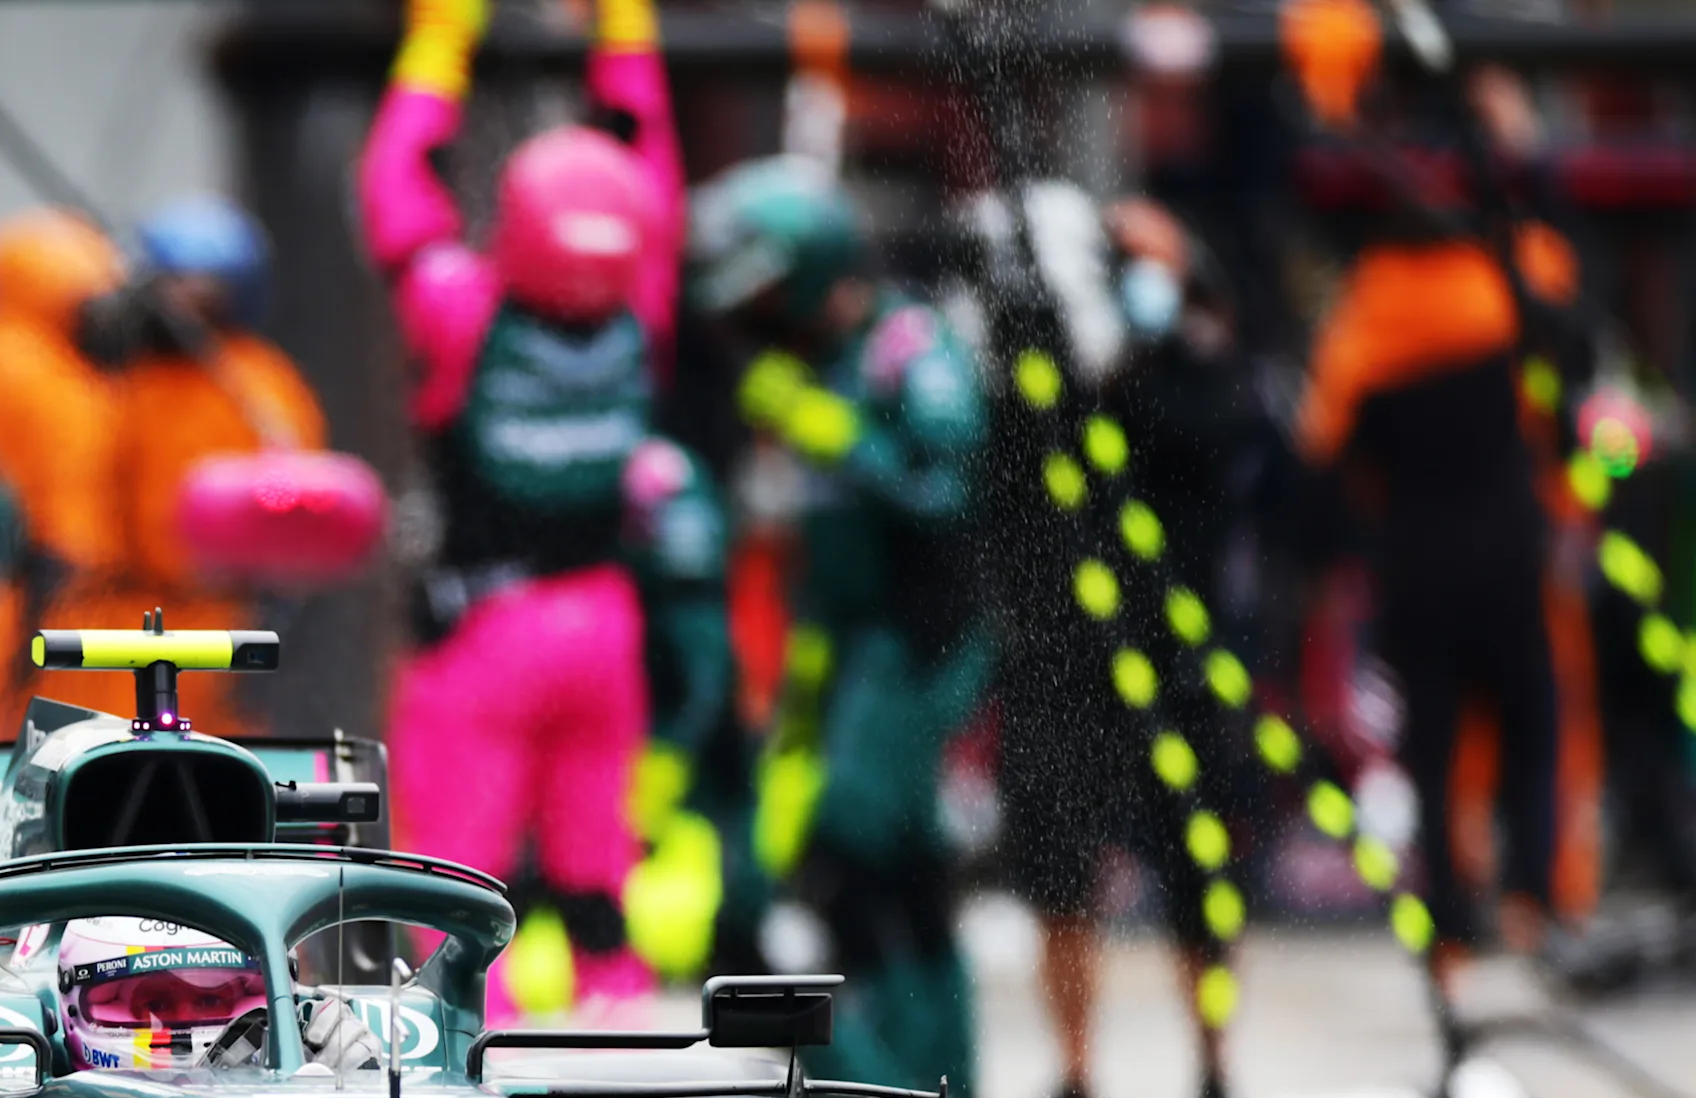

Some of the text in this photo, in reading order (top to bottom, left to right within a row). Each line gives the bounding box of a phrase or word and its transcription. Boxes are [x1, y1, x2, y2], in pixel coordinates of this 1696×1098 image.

[96, 958, 127, 974] PERONI
[132, 950, 243, 971] ASTON MARTIN
[92, 1049, 121, 1069] BWT
